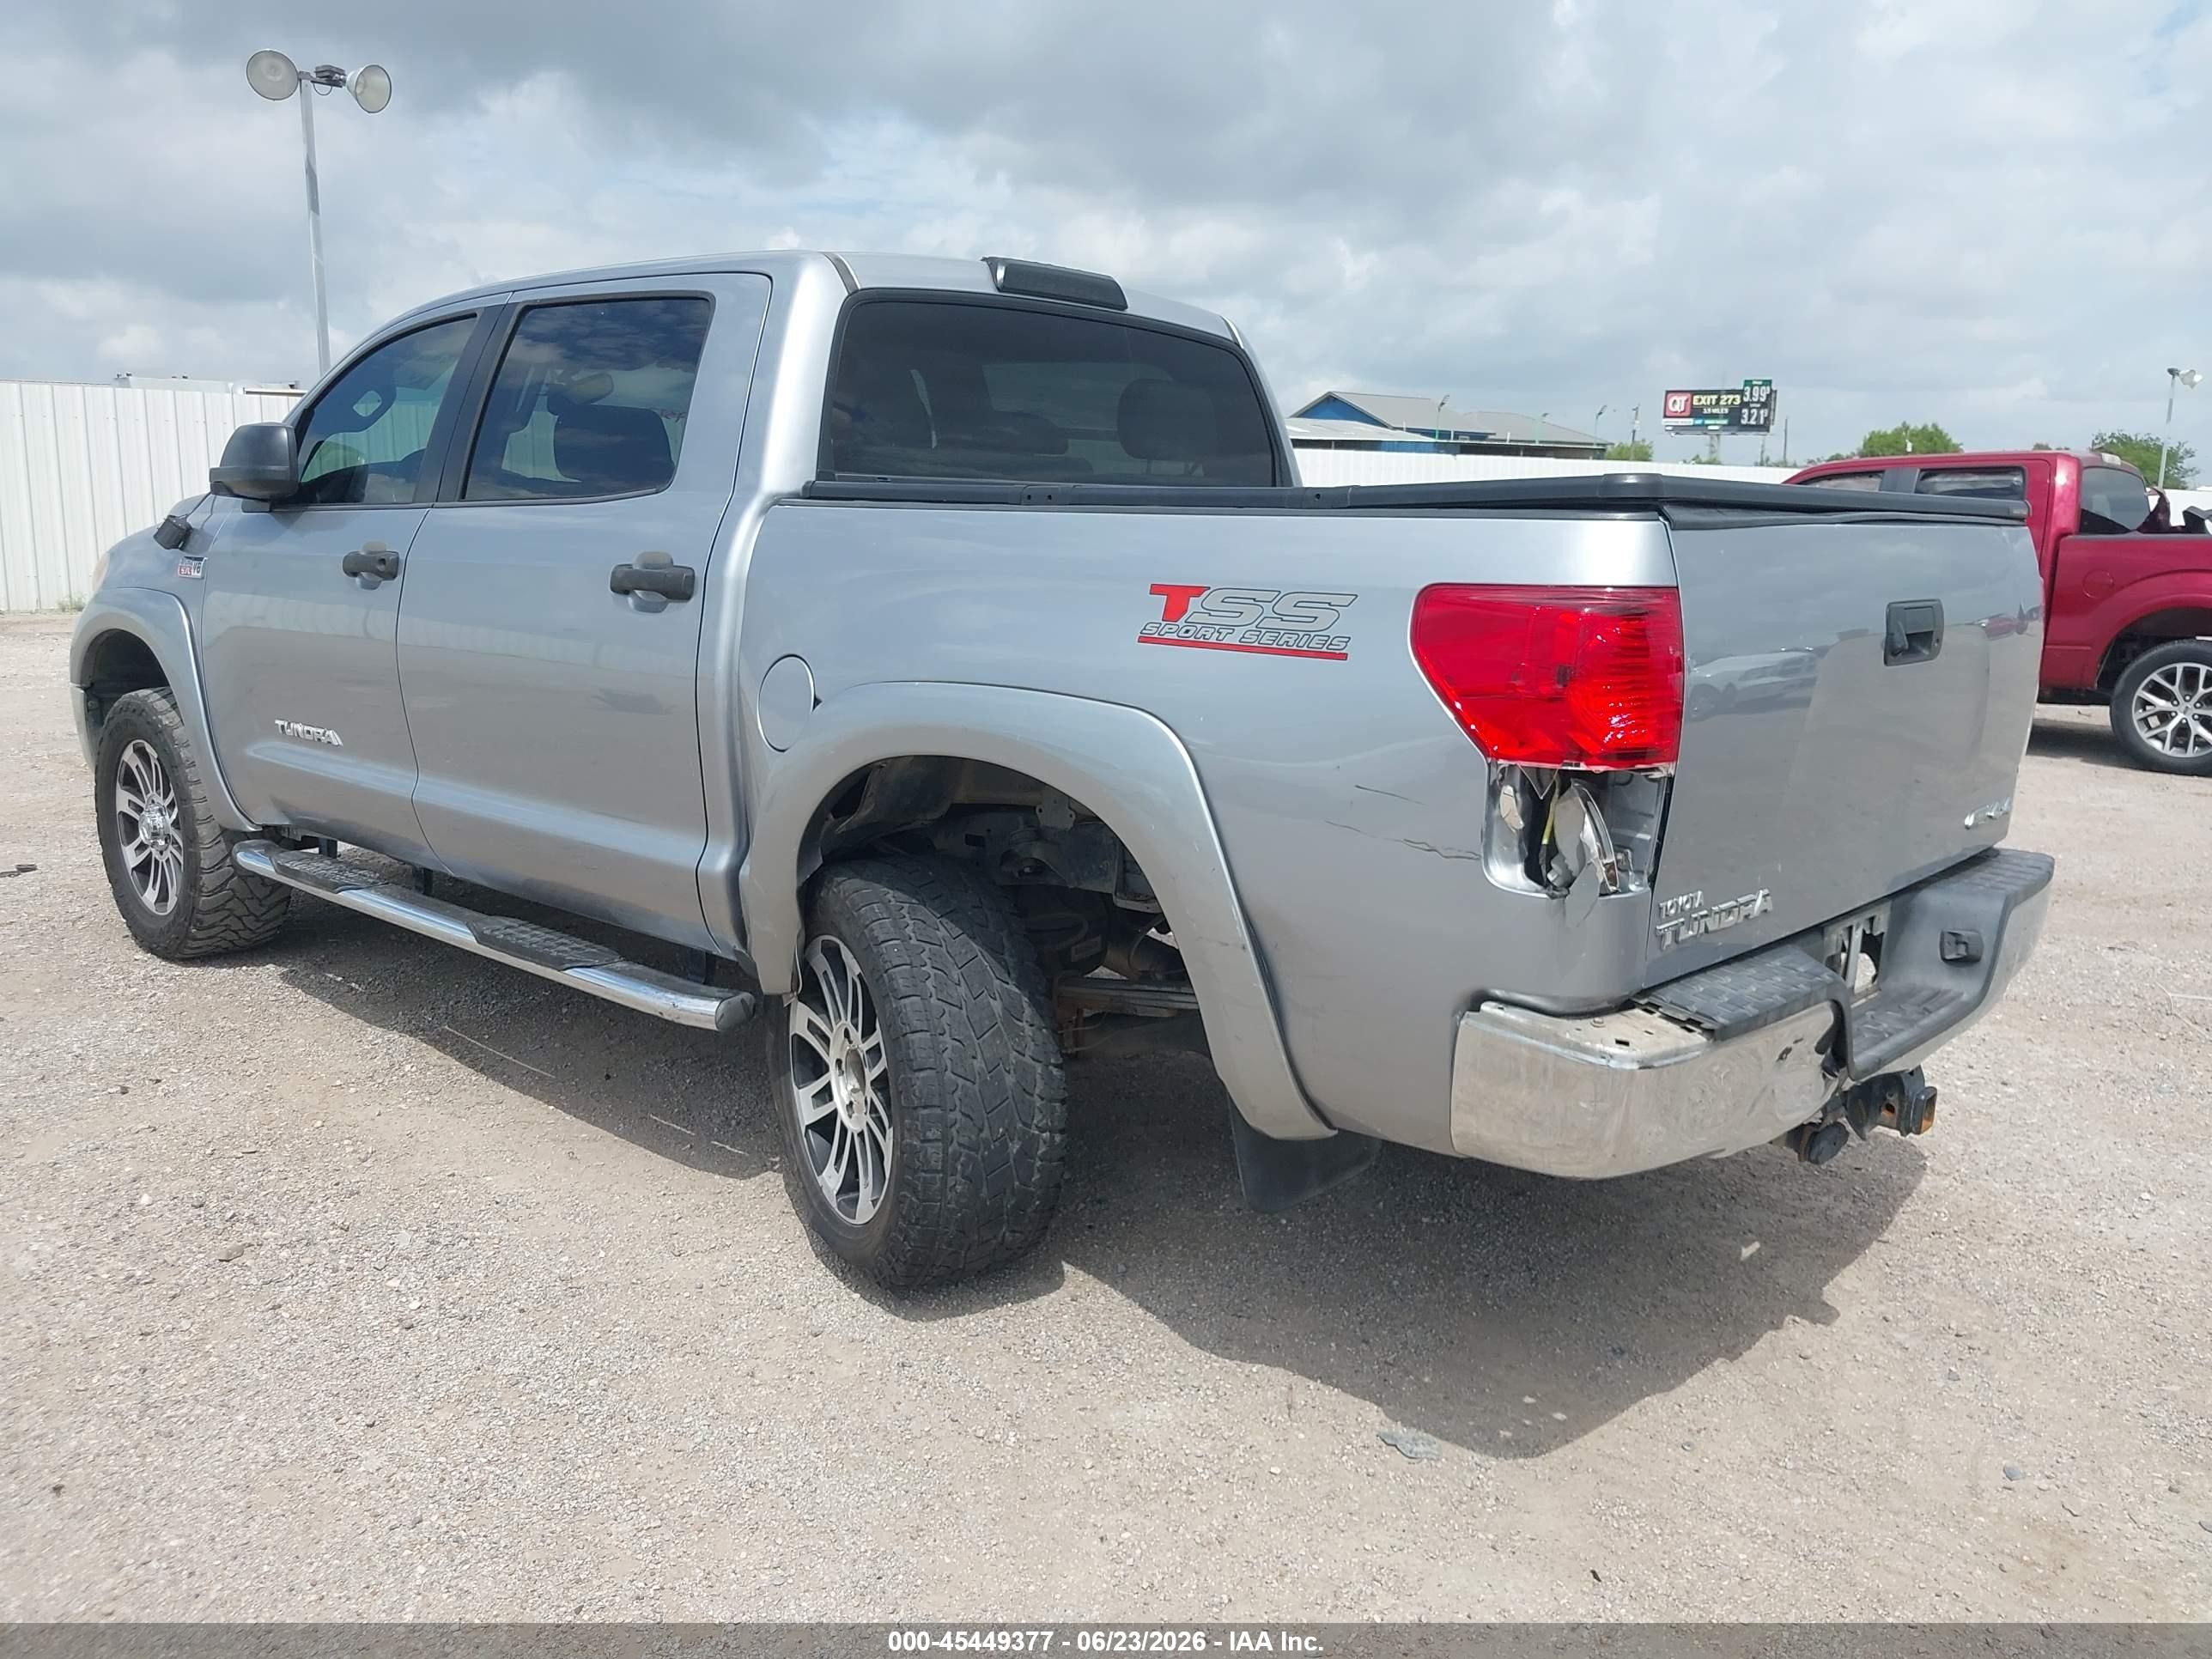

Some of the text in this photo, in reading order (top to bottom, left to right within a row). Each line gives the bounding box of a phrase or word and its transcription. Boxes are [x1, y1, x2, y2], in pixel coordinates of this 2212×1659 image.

[1668, 396, 1688, 412] QT
[1692, 395, 1741, 405] EXIT 273
[1149, 583, 1358, 633] TSS
[1140, 622, 1351, 651] SPORT SERIES
[275, 719, 343, 746] TUNDRA
[1656, 887, 1773, 950] TUNDRA
[1658, 890, 1705, 919] TOYOTA
